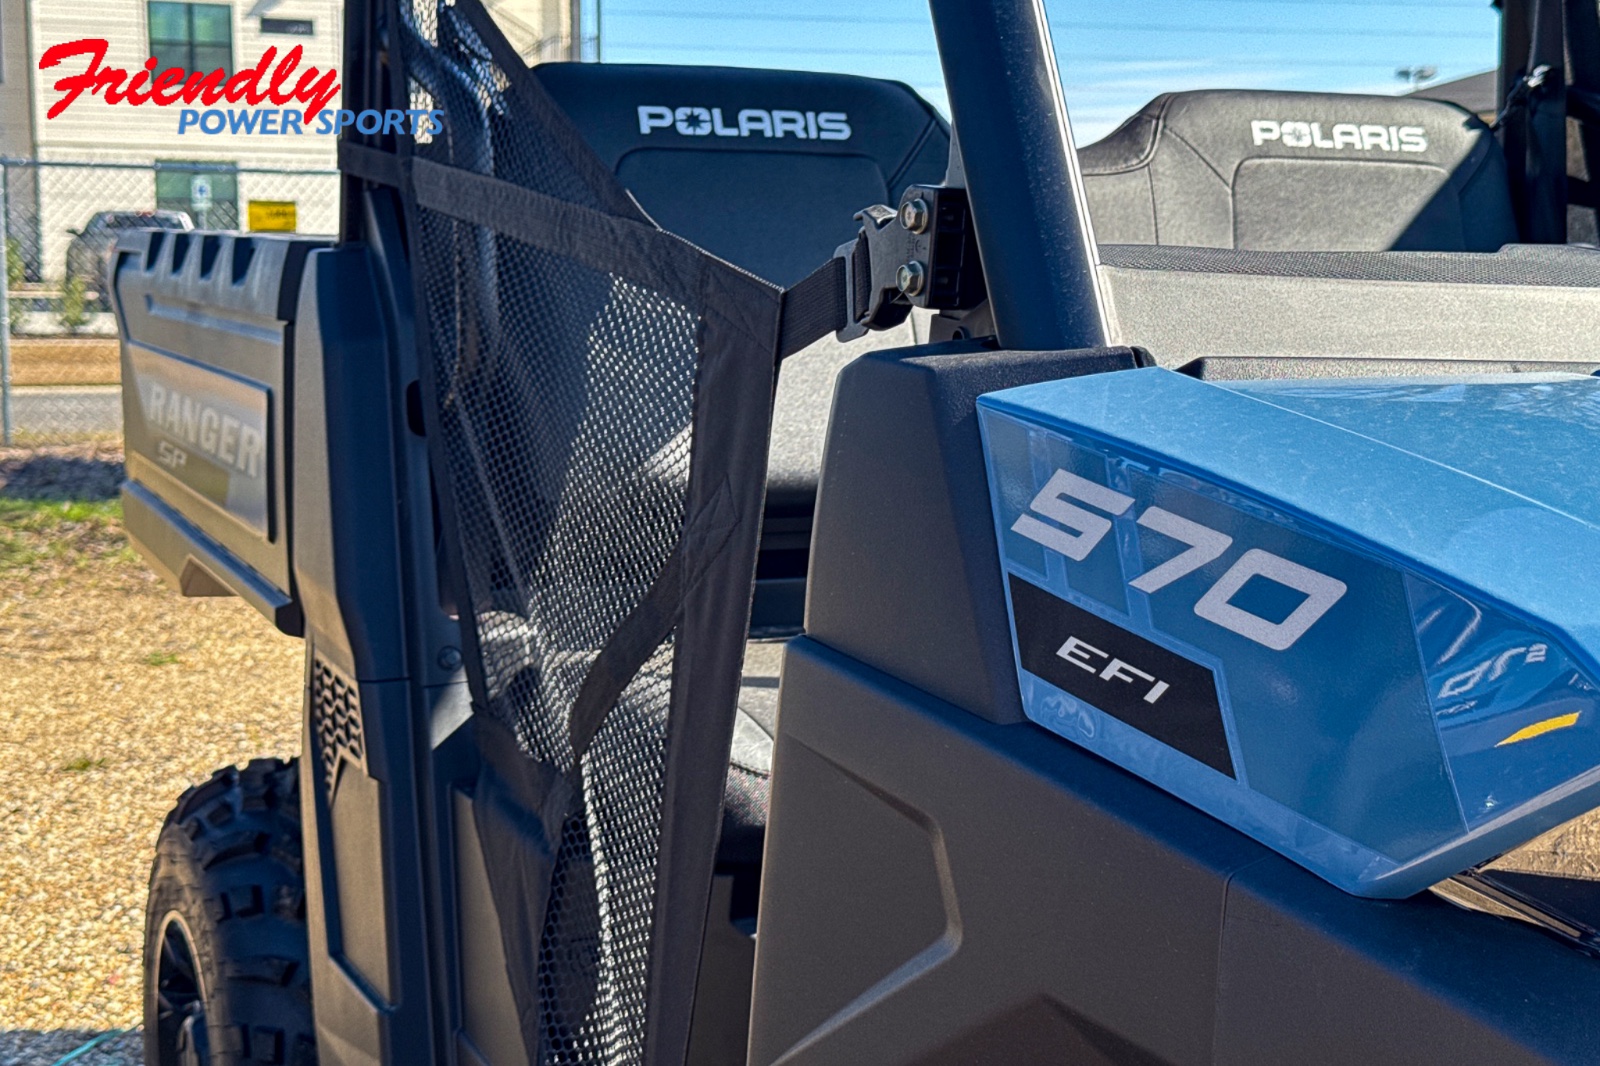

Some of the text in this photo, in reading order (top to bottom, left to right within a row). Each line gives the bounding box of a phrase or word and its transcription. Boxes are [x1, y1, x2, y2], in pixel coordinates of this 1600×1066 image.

[637, 105, 852, 141] POLARIS
[1250, 119, 1429, 152] POLARIS
[147, 381, 264, 480] RANGER
[157, 440, 188, 469] SP
[1010, 468, 1348, 651] 570
[1056, 635, 1170, 704] EFI
